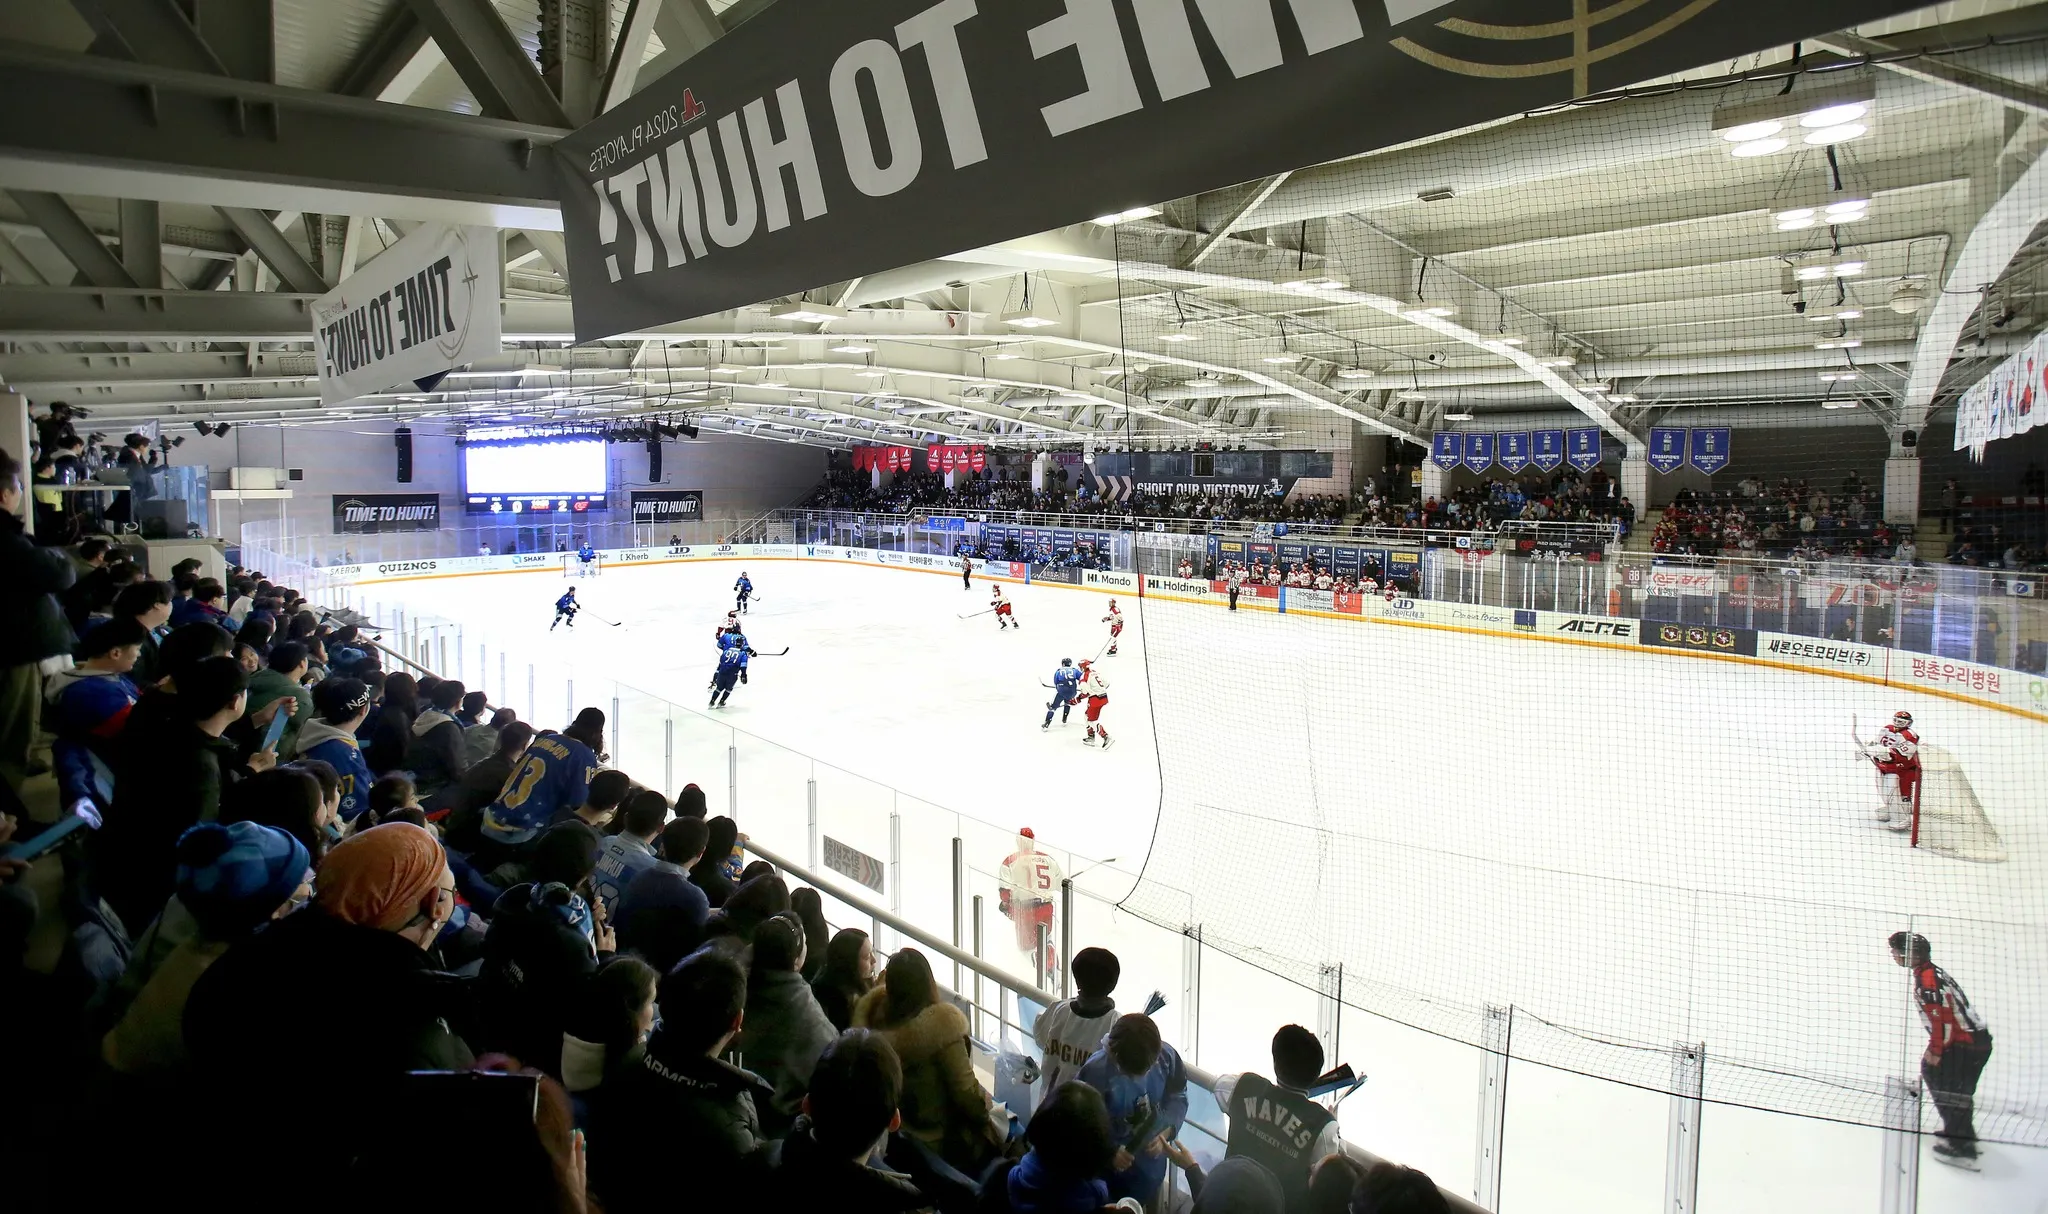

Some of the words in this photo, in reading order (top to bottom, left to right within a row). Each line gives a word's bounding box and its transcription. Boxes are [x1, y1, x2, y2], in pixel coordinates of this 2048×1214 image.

[345, 506, 379, 522] TIME
[379, 506, 396, 521] TO
[396, 505, 436, 521] HUNT!
[557, 500, 567, 512] 2
[634, 501, 656, 514] TIME
[657, 500, 669, 514] TO
[669, 500, 696, 513] HUNT!
[378, 561, 437, 574] QUIZNOS
[1087, 573, 1100, 583] HL
[1101, 575, 1131, 587] Mando
[1148, 579, 1163, 589] HL
[1164, 579, 1208, 596] Holdings
[1392, 600, 1415, 609] JD
[724, 652, 739, 664] 97
[1767, 639, 1871, 667] 새론오토모티브(주)
[1911, 657, 2001, 694] 평촌우리병원
[495, 752, 546, 810] 13
[1243, 1096, 1313, 1149] WAVES
[1255, 1128, 1280, 1149] HOCKEY
[1281, 1142, 1300, 1159] CLUB
